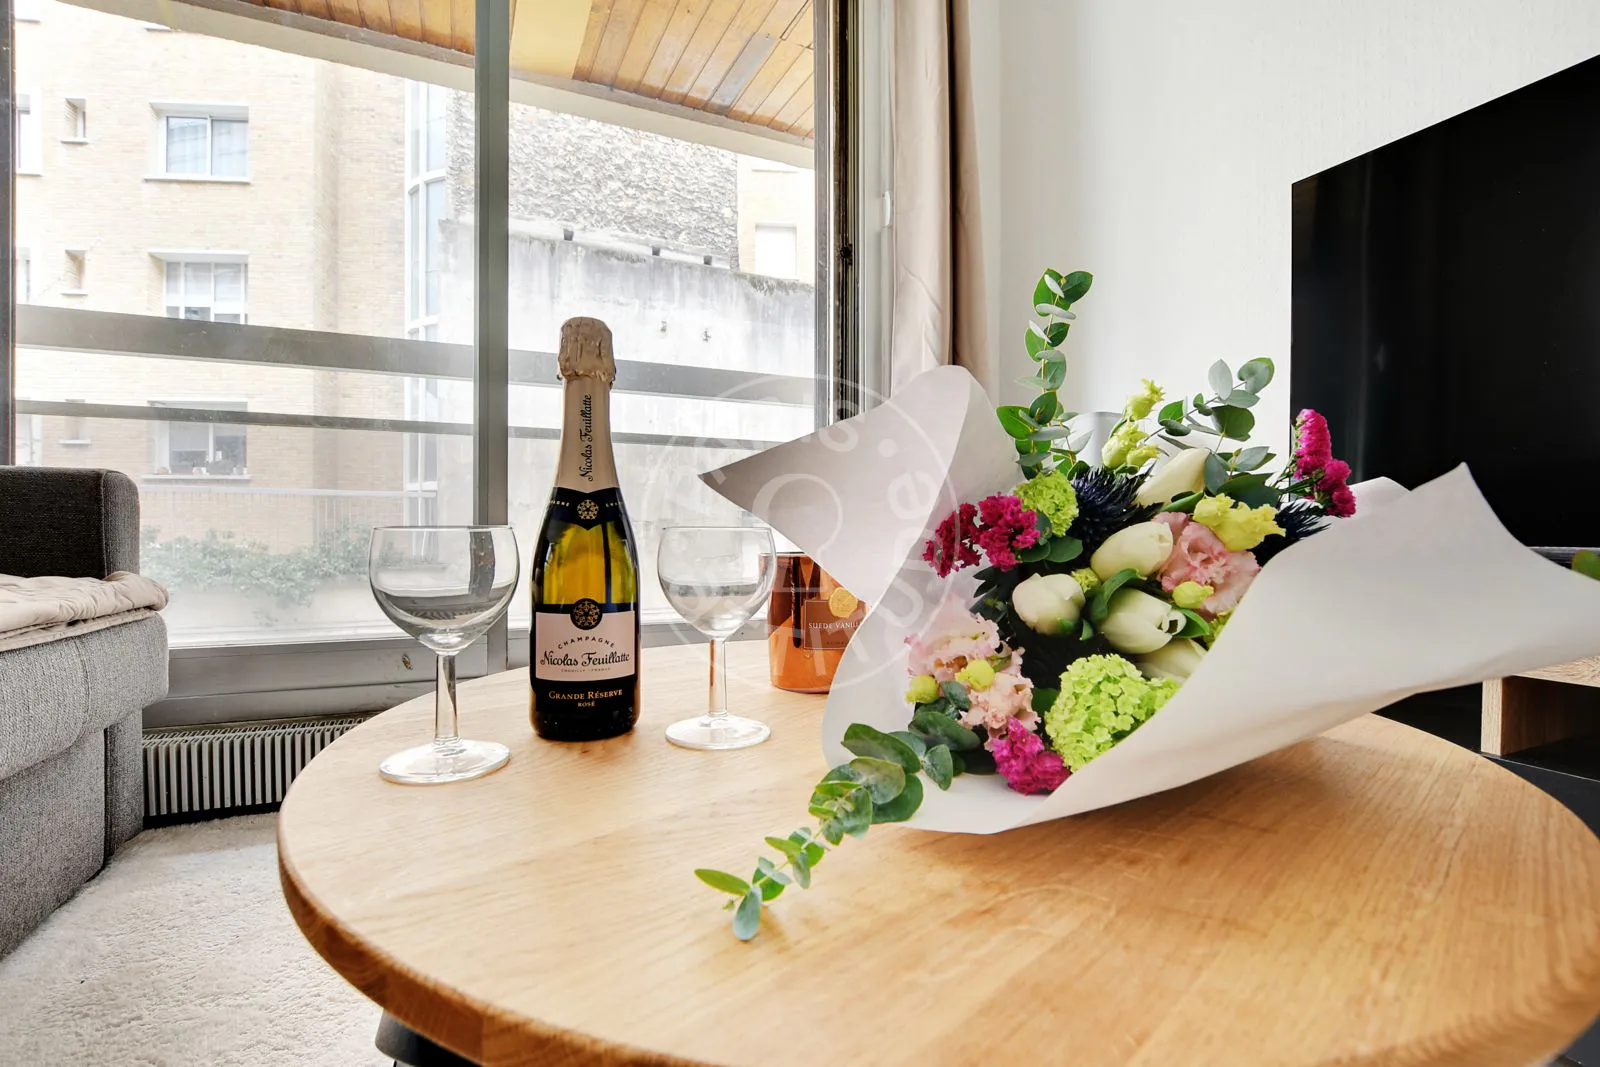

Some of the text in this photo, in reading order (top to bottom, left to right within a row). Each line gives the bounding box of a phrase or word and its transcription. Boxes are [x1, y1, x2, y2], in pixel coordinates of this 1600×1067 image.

[579, 394, 593, 482] Nicolas Feuillatte
[557, 636, 615, 650] CHAMPAGNE
[540, 650, 631, 667] Nicolas Feuillatte
[548, 689, 623, 700] GRANDE RÉSERVE
